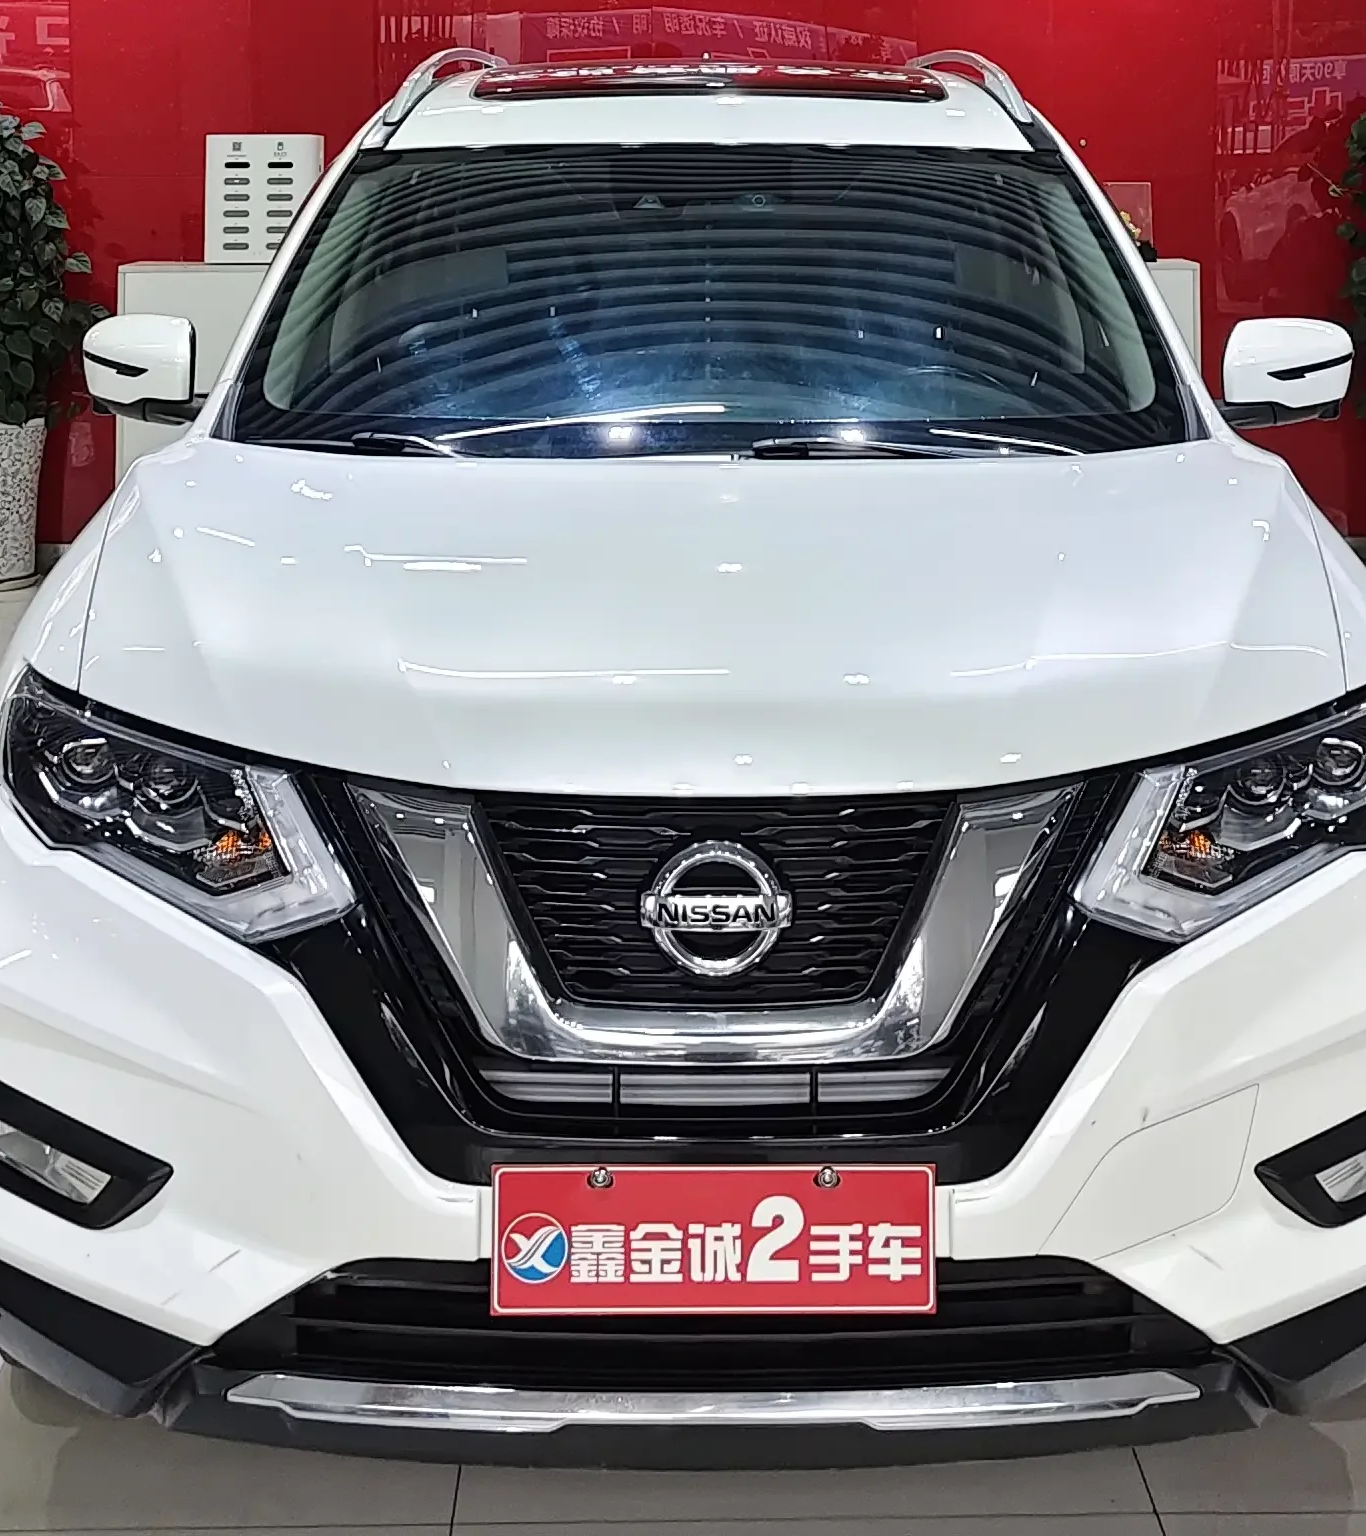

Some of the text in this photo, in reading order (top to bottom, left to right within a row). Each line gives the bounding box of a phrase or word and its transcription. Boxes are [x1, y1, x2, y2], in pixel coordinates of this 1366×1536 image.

[657, 903, 776, 923] NISSAN
[569, 1195, 923, 1284] 鑫金诚2手车
